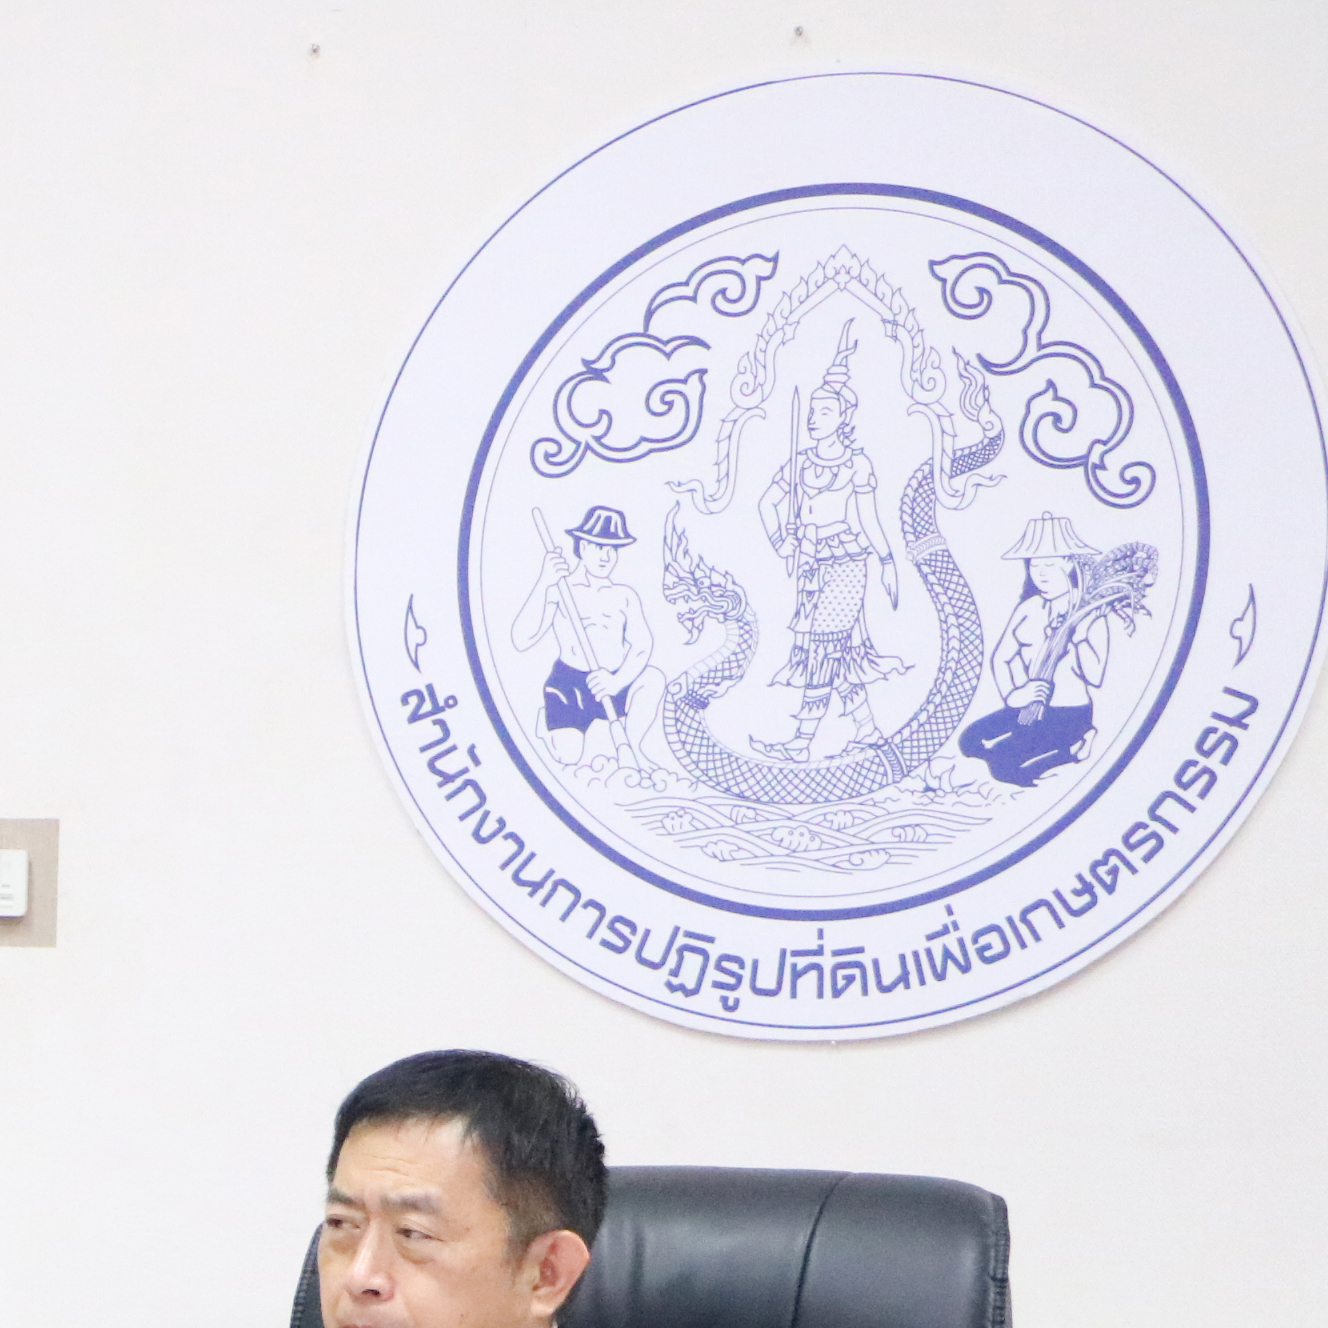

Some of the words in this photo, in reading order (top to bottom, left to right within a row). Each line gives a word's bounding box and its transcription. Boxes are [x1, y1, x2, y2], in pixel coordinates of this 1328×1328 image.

[400, 686, 1260, 1012] สำนักงานการปฏิรูปที่ดินเพื่อเกษตรกรรม
